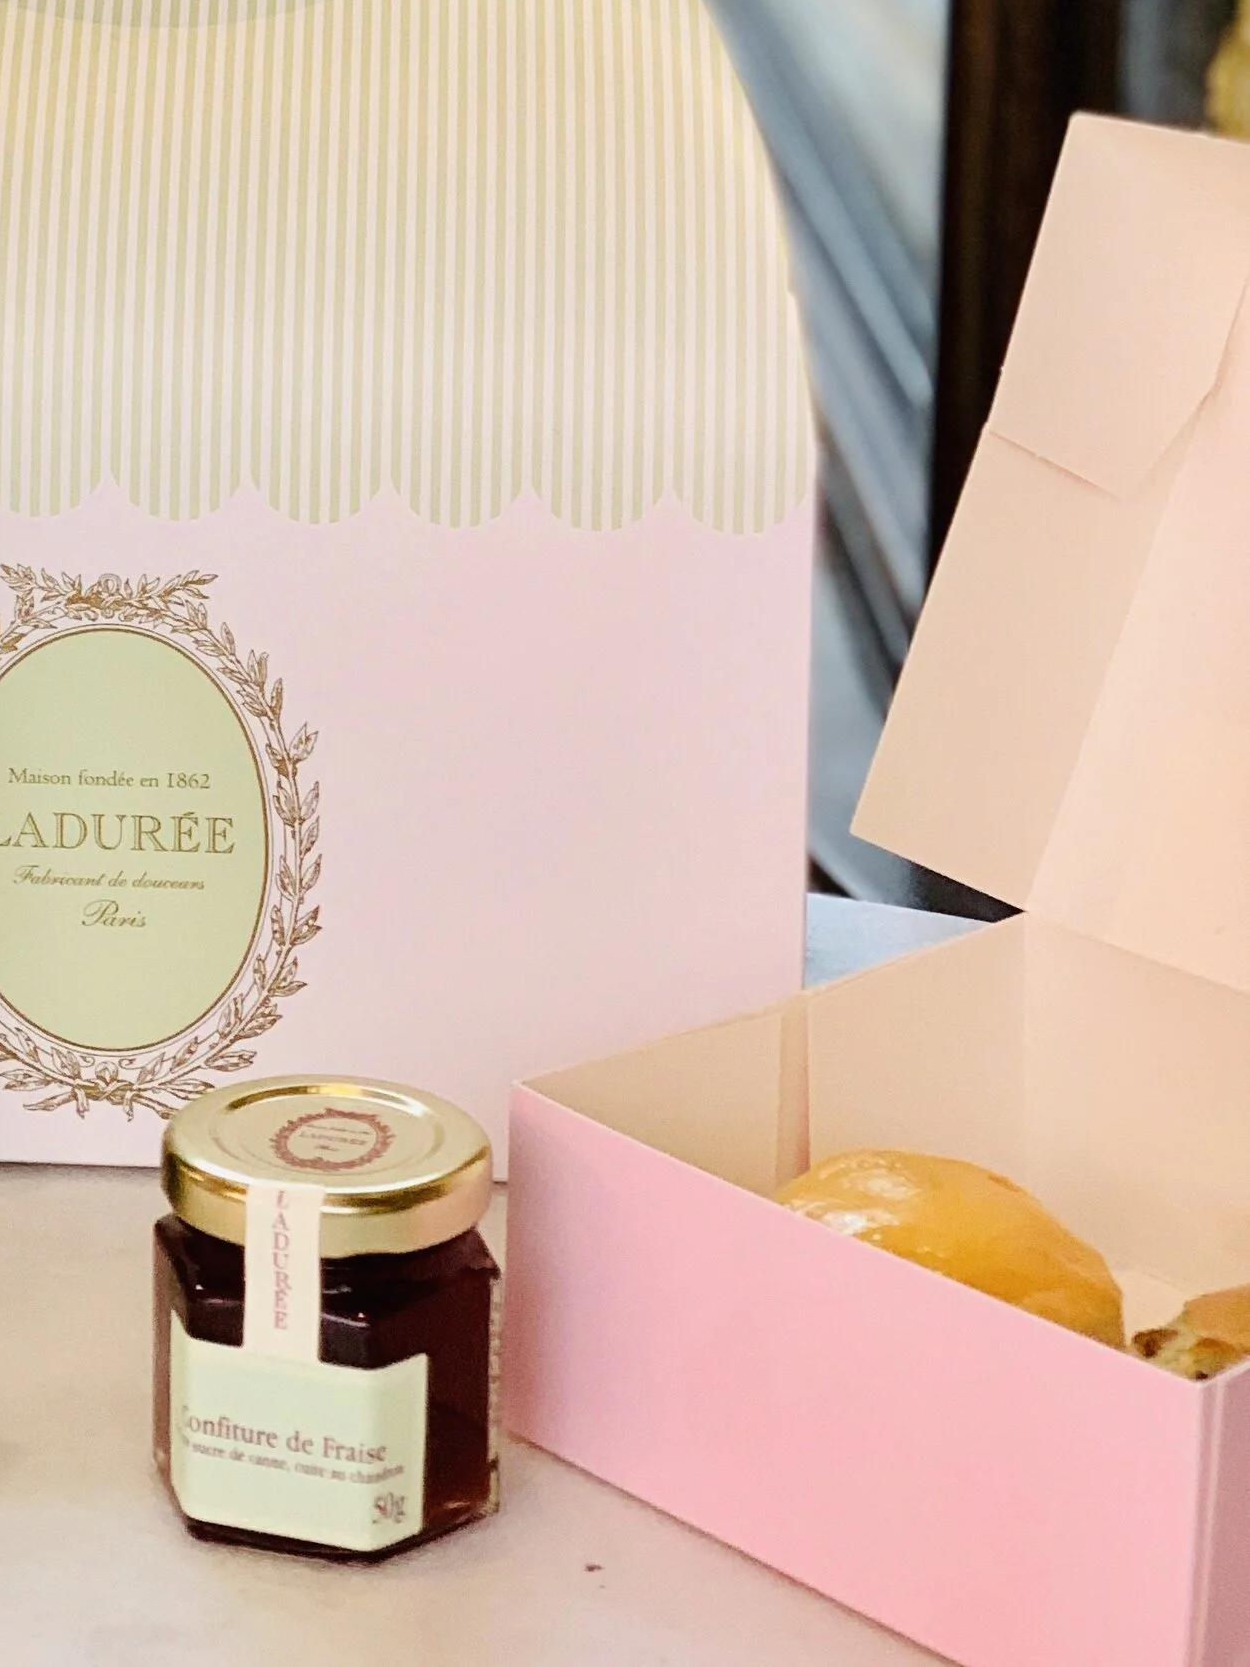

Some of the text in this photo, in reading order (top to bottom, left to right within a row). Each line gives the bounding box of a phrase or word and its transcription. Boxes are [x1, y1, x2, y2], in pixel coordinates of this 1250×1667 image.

[8, 767, 212, 790] Maison fondée en 1862
[13, 864, 206, 891] Fabricant de douceurs
[81, 898, 147, 928] Paris
[181, 1404, 278, 1449] onfiture
[286, 1430, 314, 1456] de
[322, 1435, 387, 1465] Fraise
